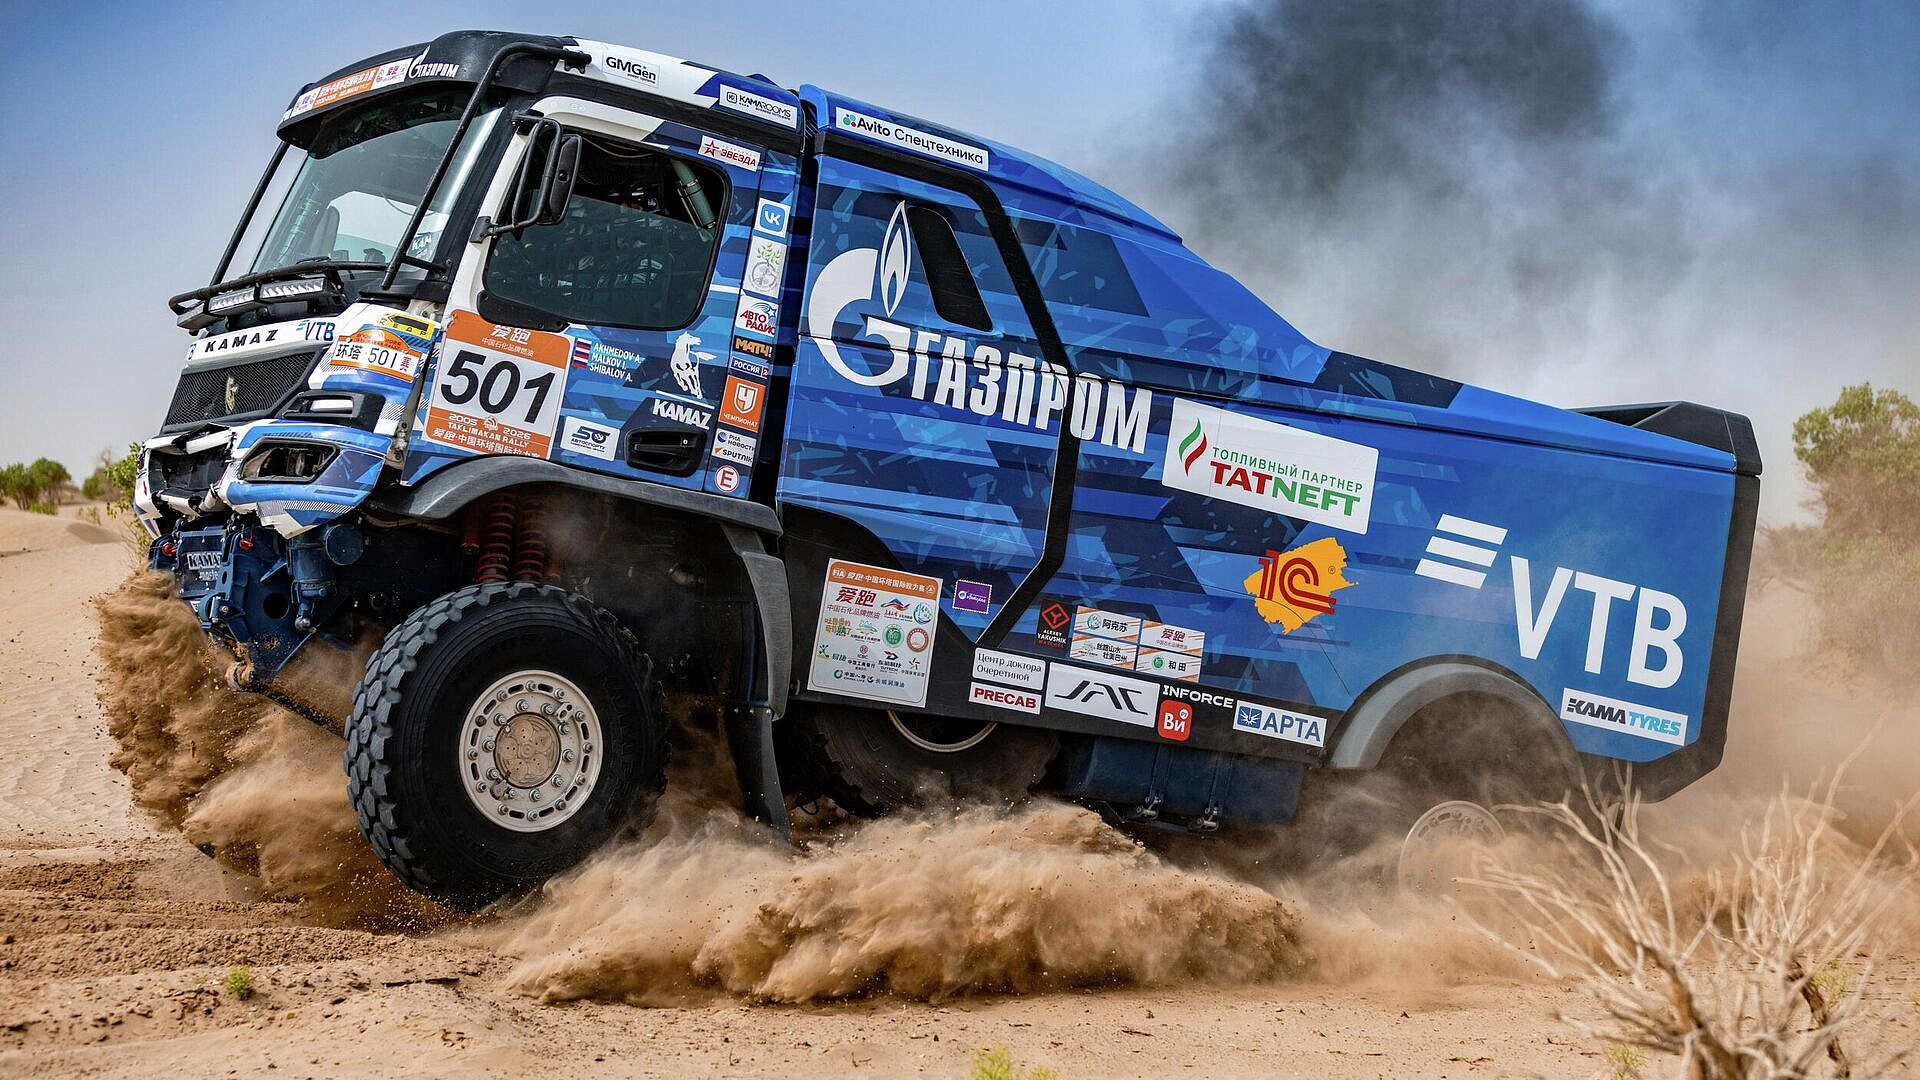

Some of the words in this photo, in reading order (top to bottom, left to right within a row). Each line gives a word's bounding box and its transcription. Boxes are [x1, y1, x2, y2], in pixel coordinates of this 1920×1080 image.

[606, 56, 656, 81] GMGen
[740, 94, 791, 118] KAMAROOMS
[857, 117, 891, 137] Avito
[894, 128, 983, 164] Спецтехника
[720, 148, 756, 166] ЗВЕЗДА
[764, 210, 781, 226] VK
[740, 310, 767, 323] АВТО
[205, 329, 279, 353] KAMAZ
[304, 321, 335, 342] VTB
[335, 343, 363, 361] 环塔
[367, 346, 397, 369] 501
[591, 352, 621, 369] MALKOV
[593, 342, 634, 361] AKHMEDOV
[634, 354, 642, 365] A.
[589, 362, 625, 380] SHIBALOV
[625, 372, 633, 383] A.
[733, 359, 761, 374] РОССИЯ
[440, 349, 556, 425] 501
[911, 330, 1152, 454] ГАЗПРОМ
[448, 413, 478, 427] 2005
[652, 398, 712, 430] KAMAZ
[723, 412, 759, 428] ЧЕМПИОНАТ
[447, 421, 501, 441] TAKLIMAKAN
[502, 435, 529, 449] RALLY
[728, 434, 742, 443] РИА
[722, 449, 753, 464] SPUTNIK
[719, 470, 734, 488] E
[1212, 446, 1298, 478] ТОПЛИВНЫЙ
[1301, 470, 1363, 493] ПАРТНЕР
[1210, 460, 1361, 517] TATNEFT
[836, 585, 877, 608] 爱跑
[827, 603, 880, 620] 中国石化品牌燃油
[1510, 554, 1688, 689] VTB
[1102, 618, 1128, 633] 阿克苏
[1161, 627, 1186, 642] 爱跑
[1037, 632, 1067, 645] YAKUSHIK
[976, 664, 1030, 682] Очеретиной
[977, 652, 1005, 667] Центр
[1006, 660, 1042, 673] доктора
[1169, 660, 1187, 672] 和田
[974, 687, 1037, 709] PRECAB
[1054, 680, 1149, 715] JAC
[1162, 684, 1234, 709] INFORCE
[1262, 711, 1321, 742] АРТА
[1566, 697, 1627, 725] KAMA
[1628, 710, 1682, 737] TYRES
